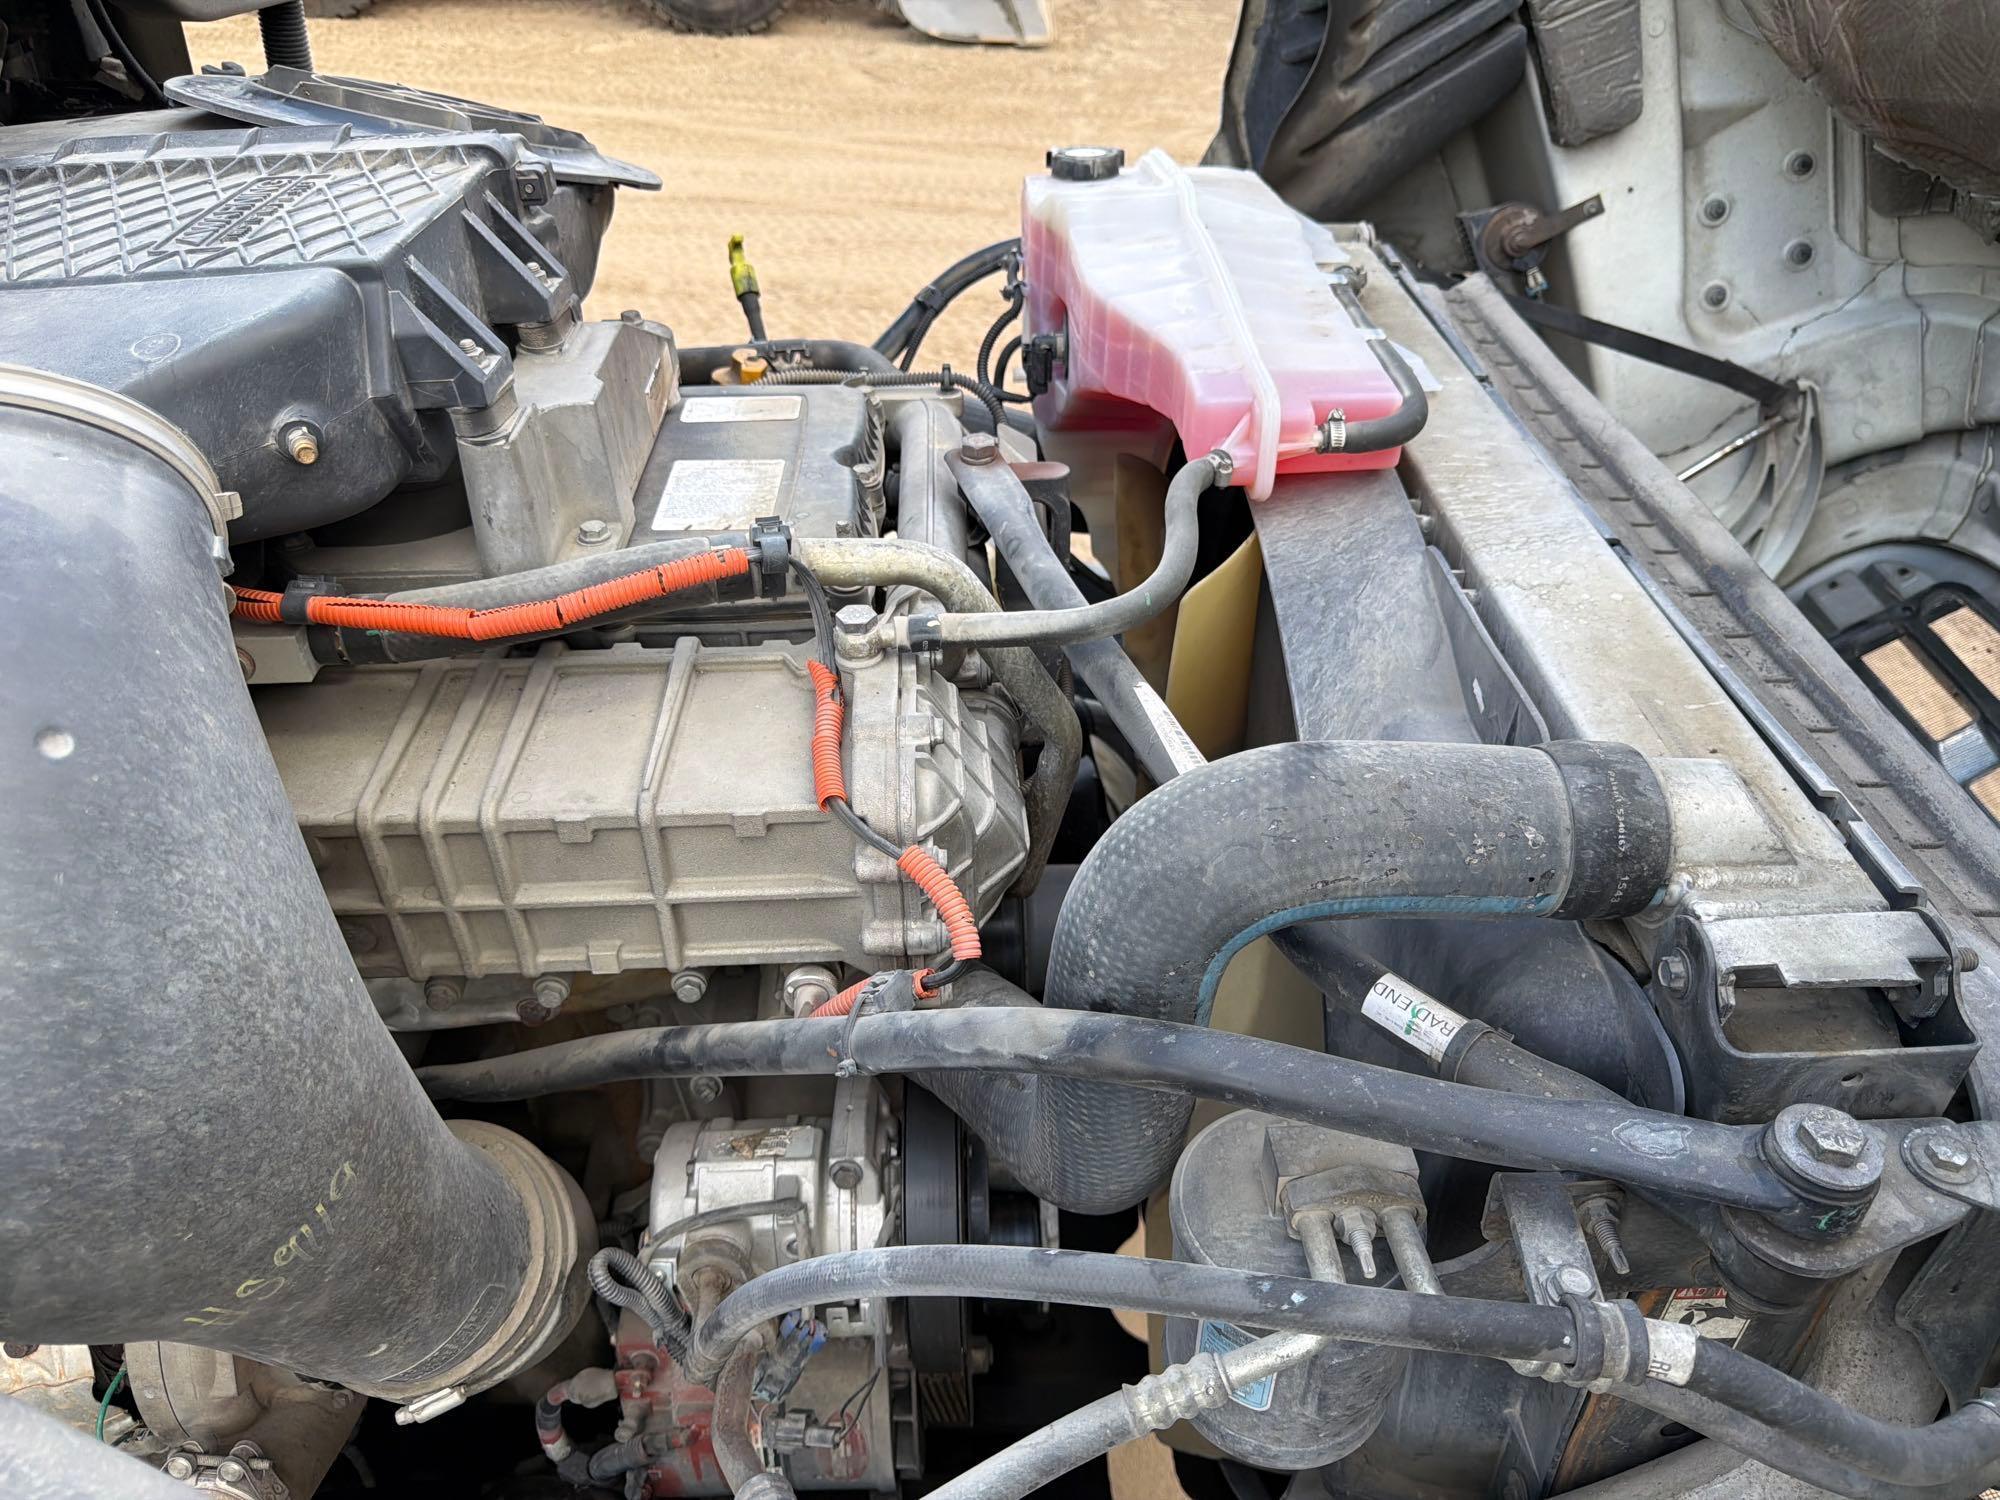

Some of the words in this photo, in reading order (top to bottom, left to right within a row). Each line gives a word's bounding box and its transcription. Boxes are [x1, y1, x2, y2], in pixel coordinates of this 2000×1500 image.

[184, 179, 291, 236] WARNING
[1373, 982, 1413, 1011] END
[1415, 1008, 1456, 1037] RAD
